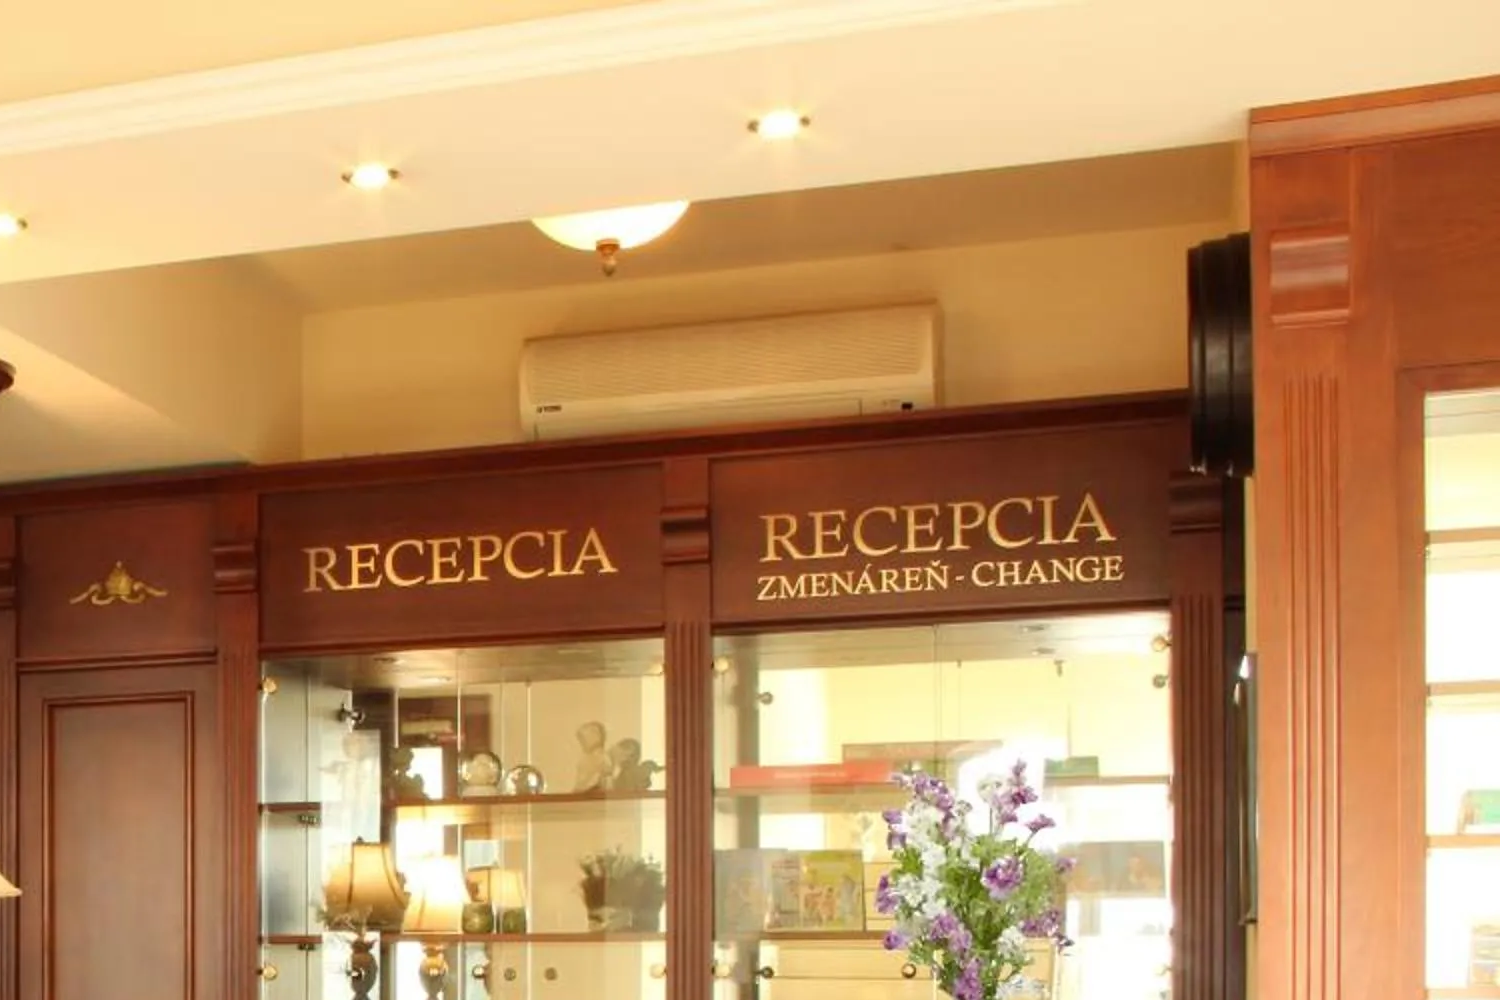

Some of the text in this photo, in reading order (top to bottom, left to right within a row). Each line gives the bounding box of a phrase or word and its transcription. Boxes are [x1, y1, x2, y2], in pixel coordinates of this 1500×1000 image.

[303, 527, 617, 592] RECEPCIA
[759, 493, 1116, 562] RECEPCIA
[757, 562, 949, 601] ZMENÁREŇ
[971, 555, 1125, 588] CHANGE
